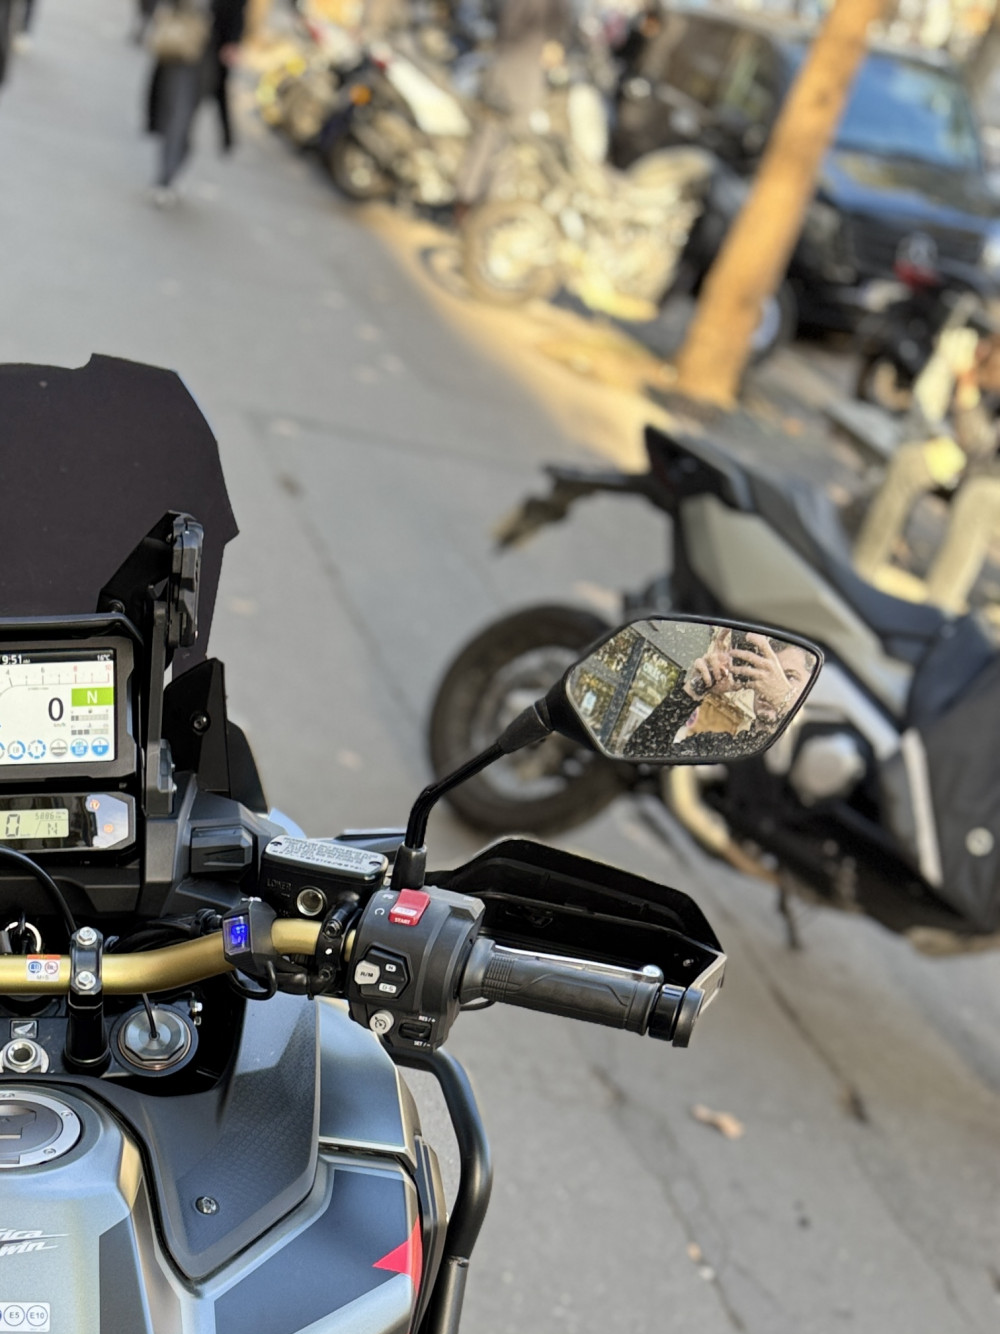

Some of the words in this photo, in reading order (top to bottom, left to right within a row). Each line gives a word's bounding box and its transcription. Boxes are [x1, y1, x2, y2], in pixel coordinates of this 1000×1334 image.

[2, 654, 22, 664] 9:51
[87, 691, 98, 704] N
[48, 697, 64, 721] 0
[5, 814, 20, 837] 0
[47, 823, 58, 835] N
